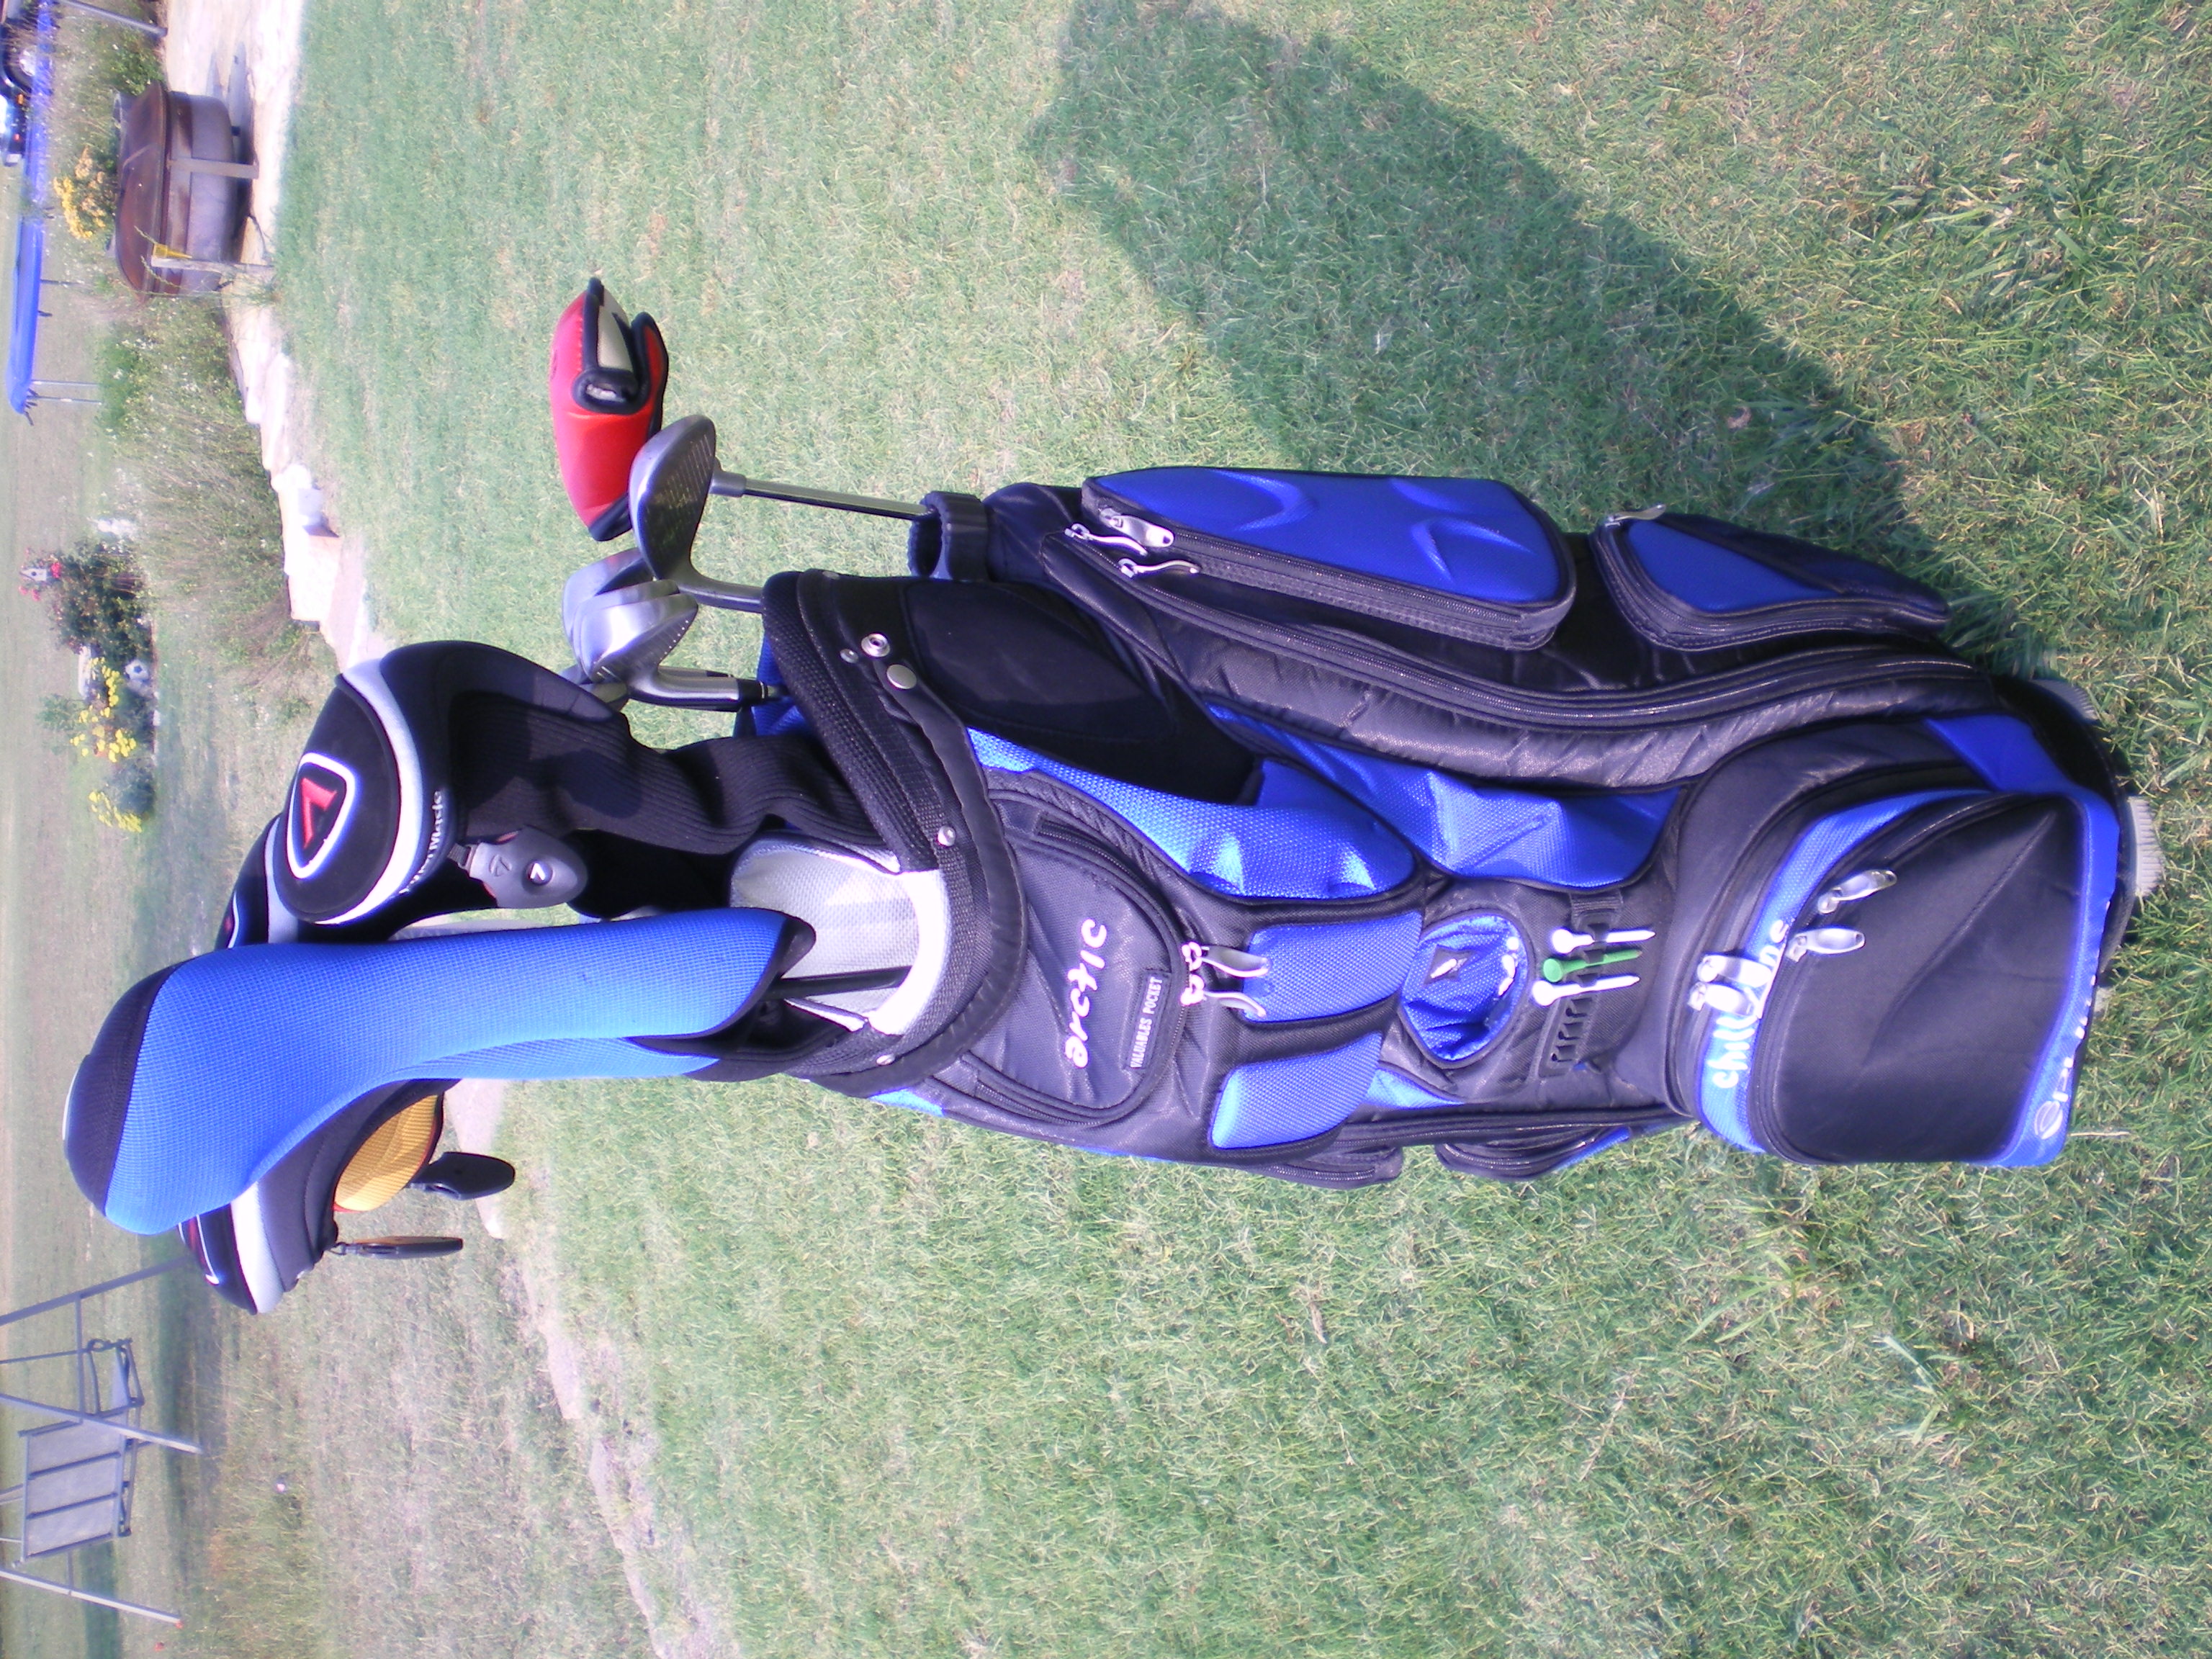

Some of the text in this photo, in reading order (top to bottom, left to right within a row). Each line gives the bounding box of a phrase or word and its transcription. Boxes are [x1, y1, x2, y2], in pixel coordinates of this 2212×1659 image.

[1064, 918, 1107, 1069] arctic
[1130, 975, 1163, 1069] VALUABLES POCKET
